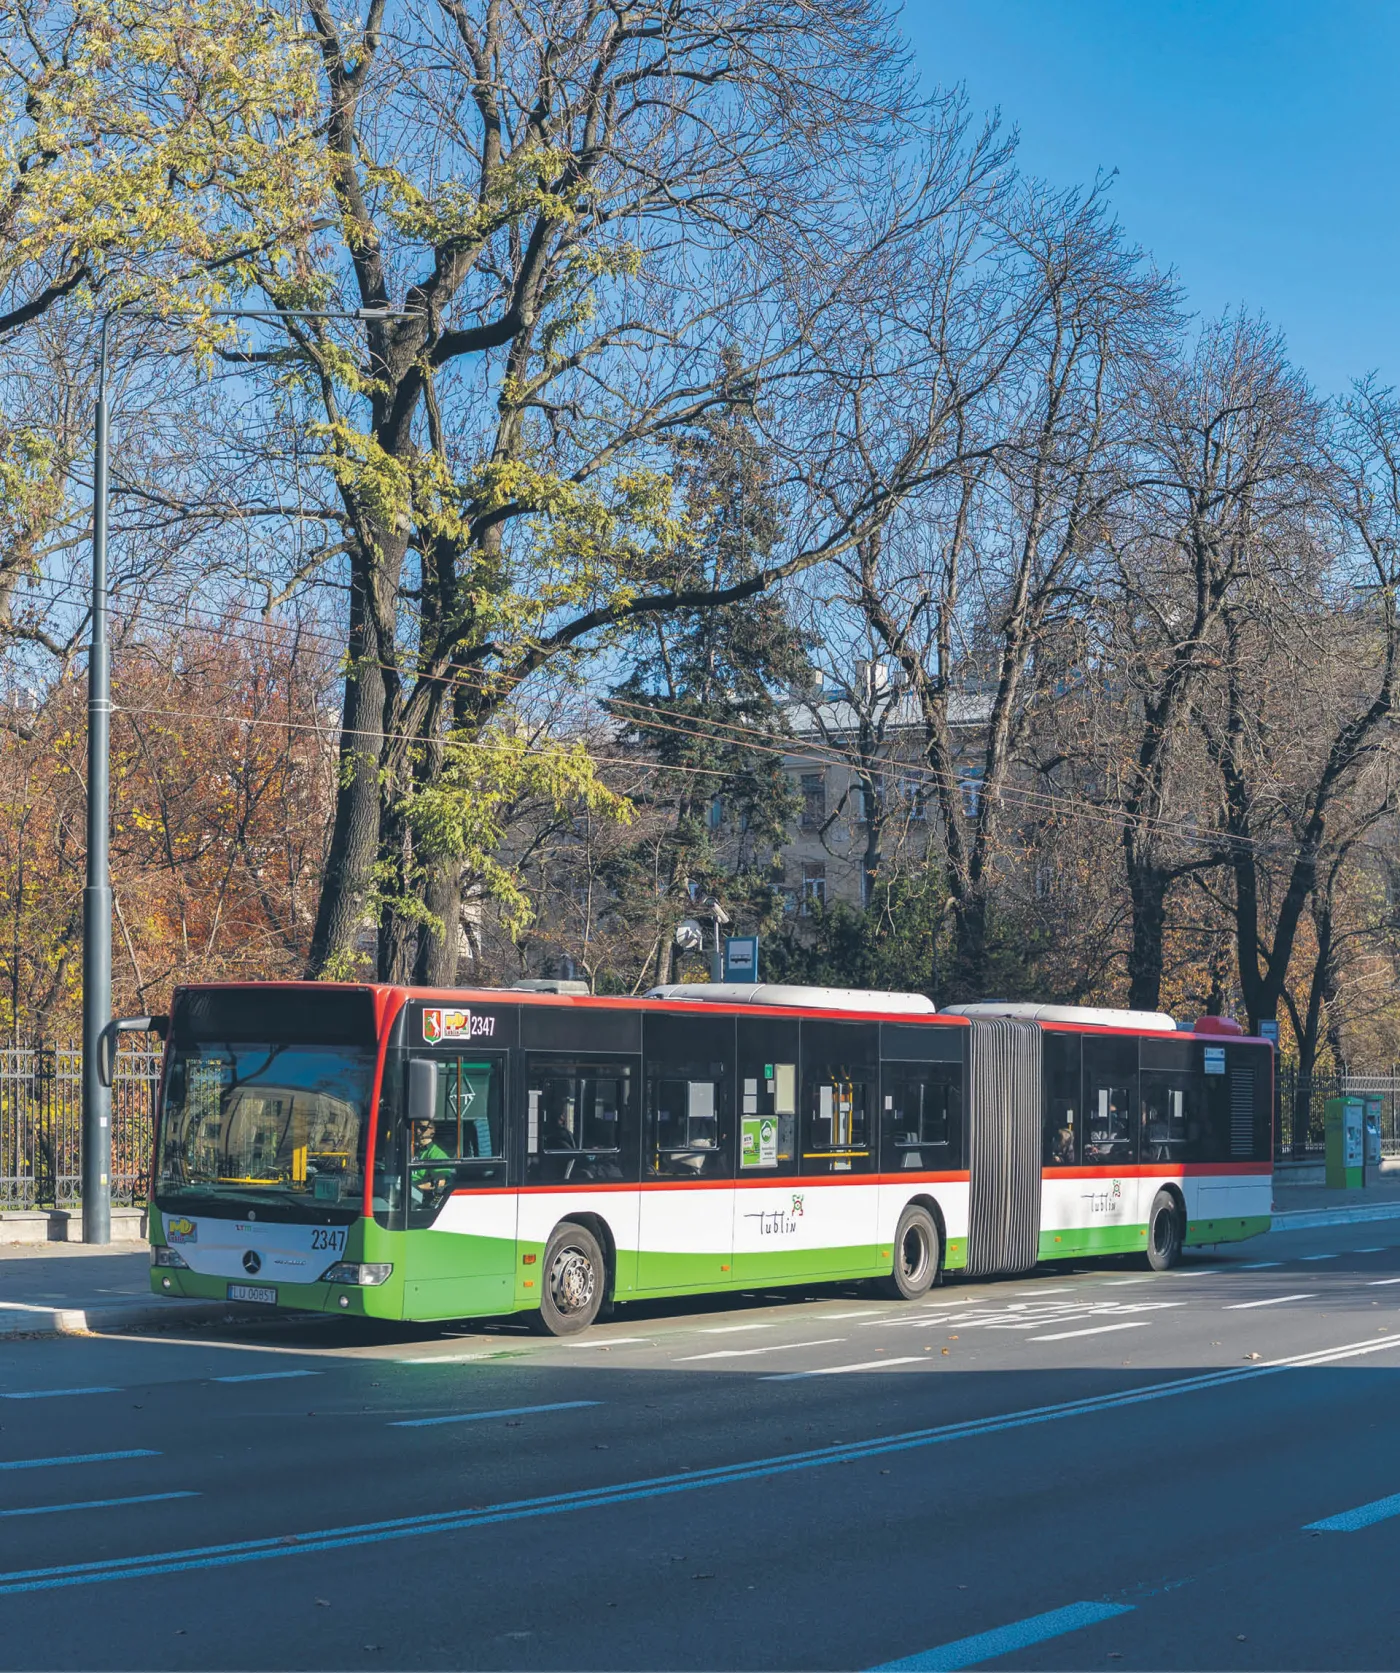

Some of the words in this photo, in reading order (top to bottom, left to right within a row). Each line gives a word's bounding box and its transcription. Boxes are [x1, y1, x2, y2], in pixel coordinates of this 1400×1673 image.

[471, 1015, 495, 1036] 2347
[311, 1229, 345, 1252] 2347
[233, 1286, 246, 1299] LU
